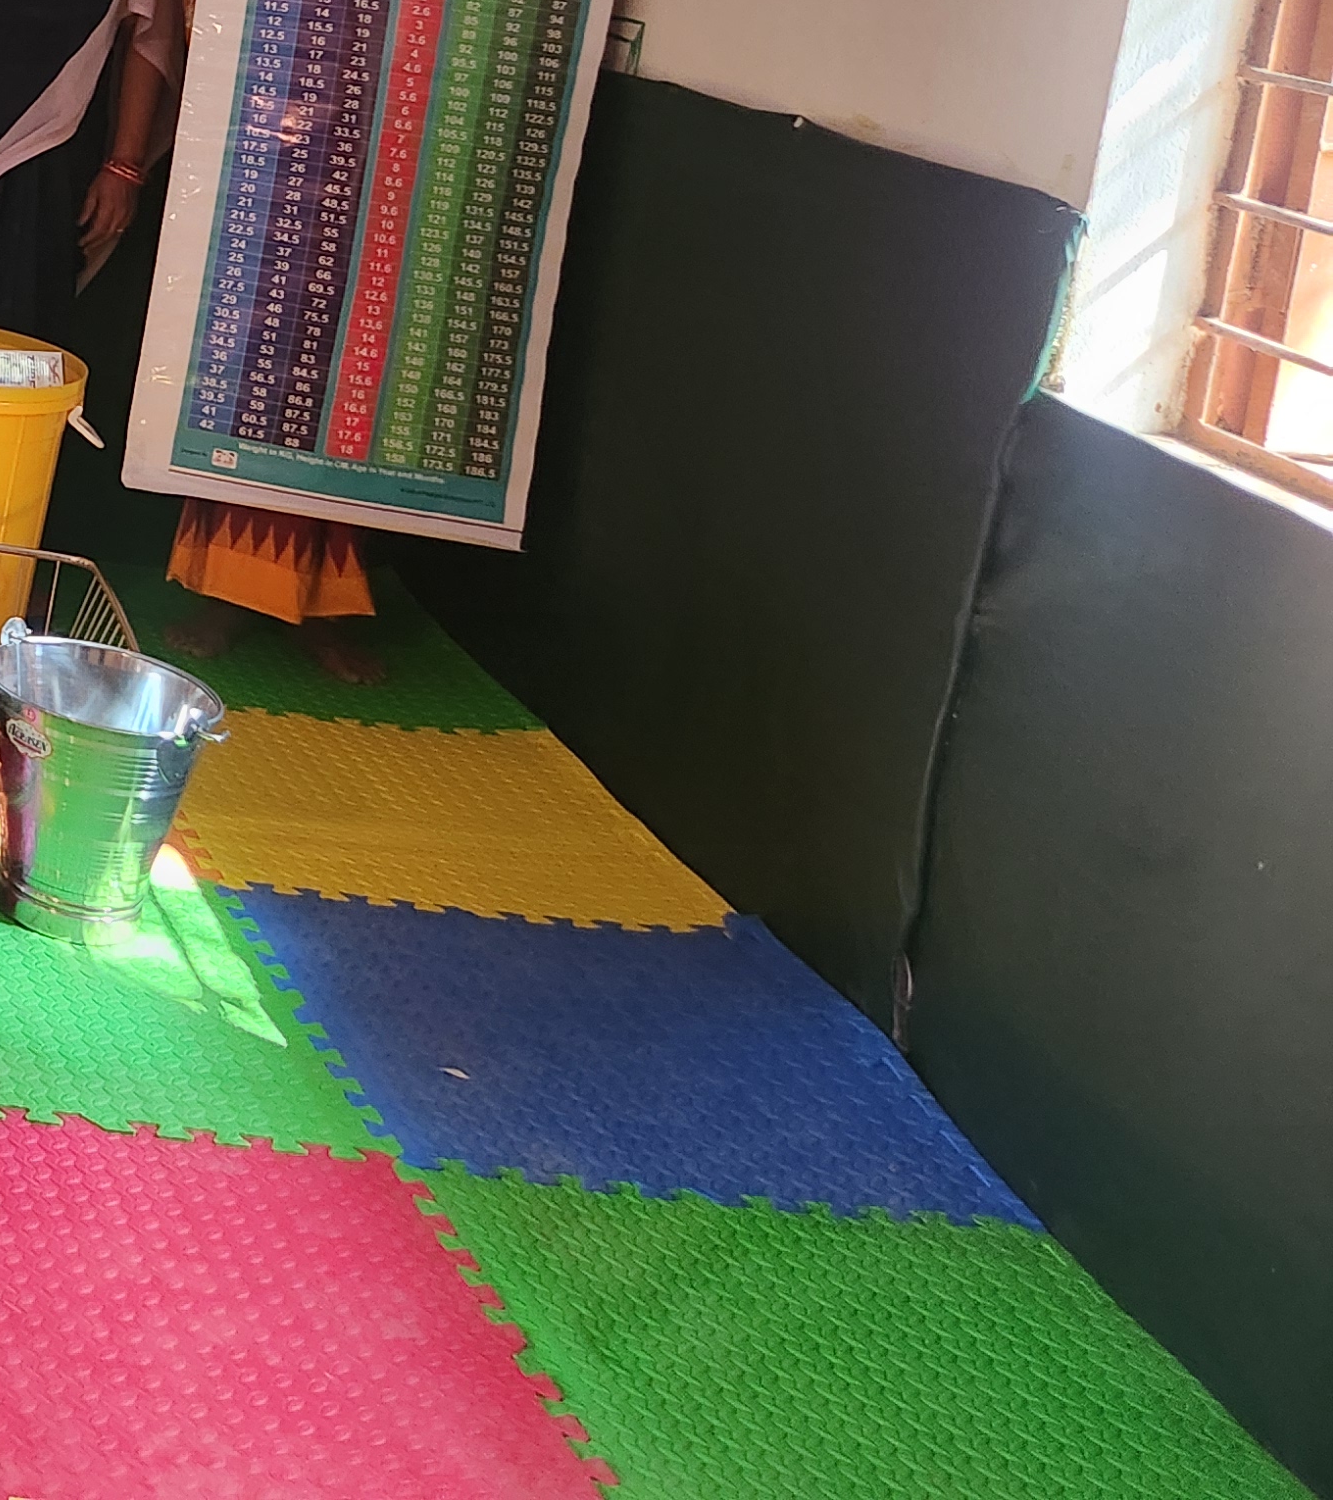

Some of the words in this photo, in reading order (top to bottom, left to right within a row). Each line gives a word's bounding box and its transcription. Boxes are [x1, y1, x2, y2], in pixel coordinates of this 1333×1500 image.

[264, 0, 289, 12] 11.5
[314, 7, 329, 17] 14
[357, 13, 372, 24] 18
[415, 20, 423, 30] 3
[411, 5, 431, 16] 2.6
[259, 29, 285, 40] 12.5
[311, 35, 326, 46] 16
[352, 41, 367, 52] 21
[410, 49, 418, 58] 4
[267, 15, 282, 26] 12
[307, 21, 333, 33] 15.5
[356, 27, 370, 38] 19
[407, 33, 426, 45] 3.6
[262, 43, 277, 53] 13
[308, 49, 324, 59] 17
[350, 55, 366, 66] 23
[402, 62, 421, 73] 4.6
[242, 168, 258, 179] 19
[287, 176, 304, 187] 27
[323, 183, 351, 196] 45.5
[387, 191, 395, 201] 9
[237, 196, 252, 207] 21
[282, 204, 298, 215] 31
[319, 211, 347, 225] 51.5
[381, 219, 394, 230] 10
[209, 363, 225, 375] 37
[249, 371, 275, 384] 56.5
[295, 381, 310, 392] 86
[351, 389, 365, 399] 16
[211, 349, 227, 361] 36
[256, 358, 272, 369] 55
[291, 366, 318, 379] 84.5
[348, 374, 372, 386] 15.6
[198, 389, 225, 403] 39.5
[249, 399, 265, 411] 59
[284, 408, 310, 421] 87.5
[345, 416, 359, 426] 17
[201, 376, 227, 389] 38.5
[251, 386, 267, 397] 58
[287, 394, 313, 407] 86.8
[343, 401, 367, 414] 16.6
[199, 419, 215, 430] 42
[238, 426, 265, 439] 61.5
[284, 437, 300, 447] 88
[340, 444, 354, 455] 18
[201, 405, 216, 416] 41
[241, 412, 267, 426] 60.5
[281, 422, 308, 435] 87.5
[337, 429, 361, 442] 17.6
